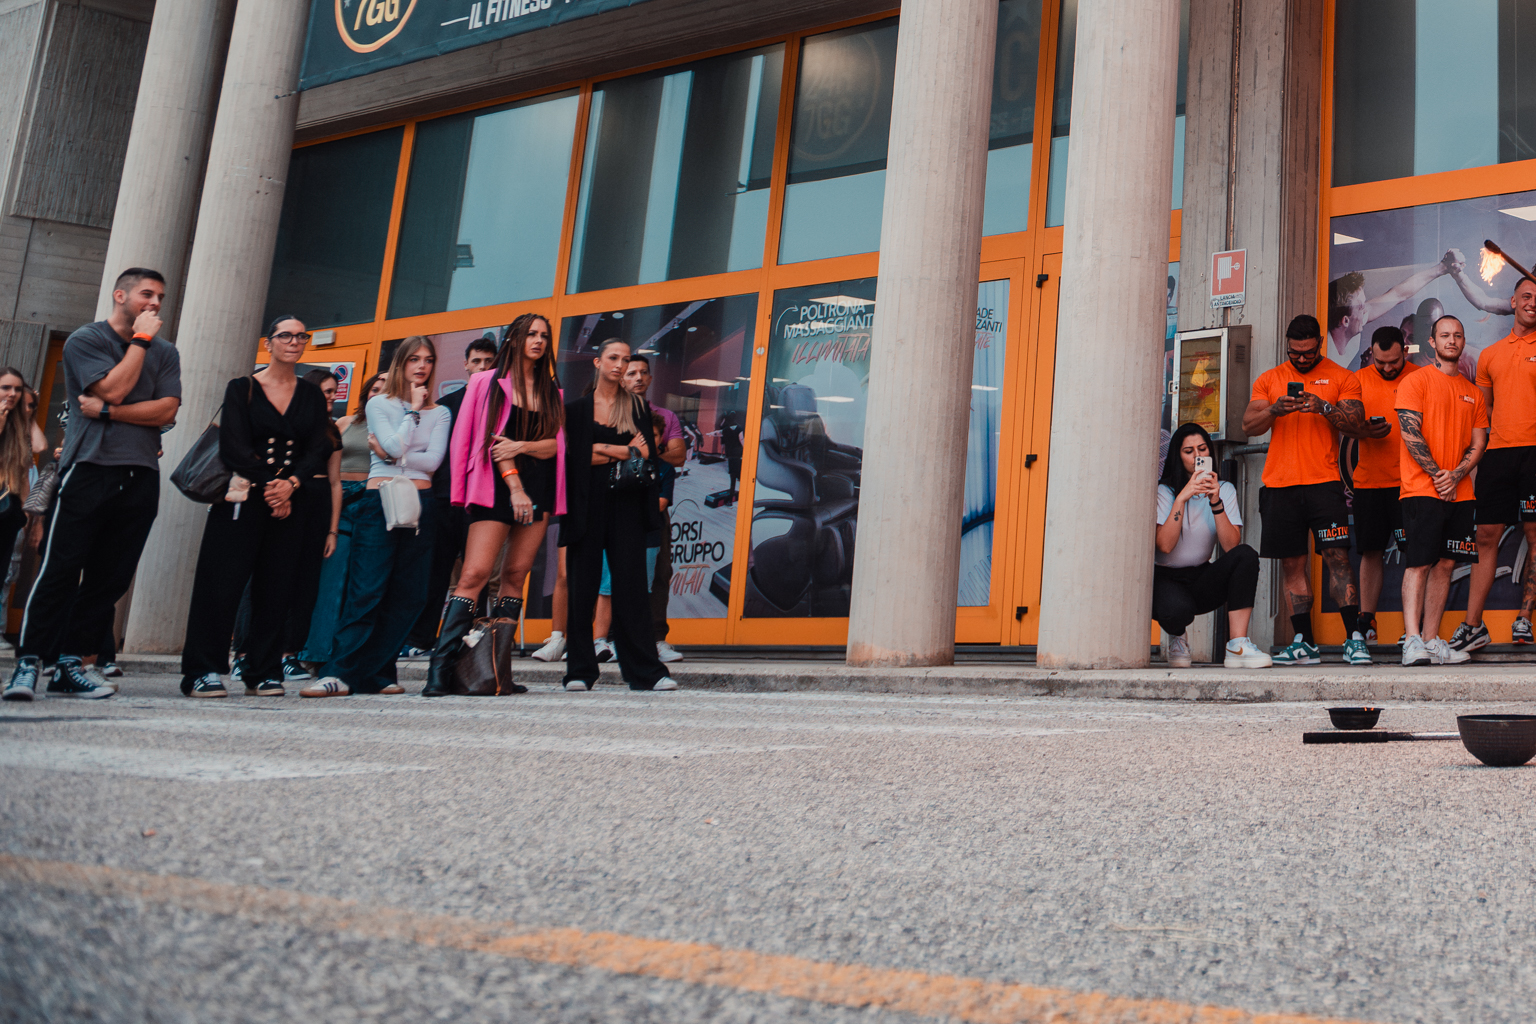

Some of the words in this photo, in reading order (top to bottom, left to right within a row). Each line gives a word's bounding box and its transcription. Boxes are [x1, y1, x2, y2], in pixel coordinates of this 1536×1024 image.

[468, 2, 483, 30] IL
[800, 299, 865, 322] POLTRONA
[784, 313, 874, 339] MASSAGGIANT
